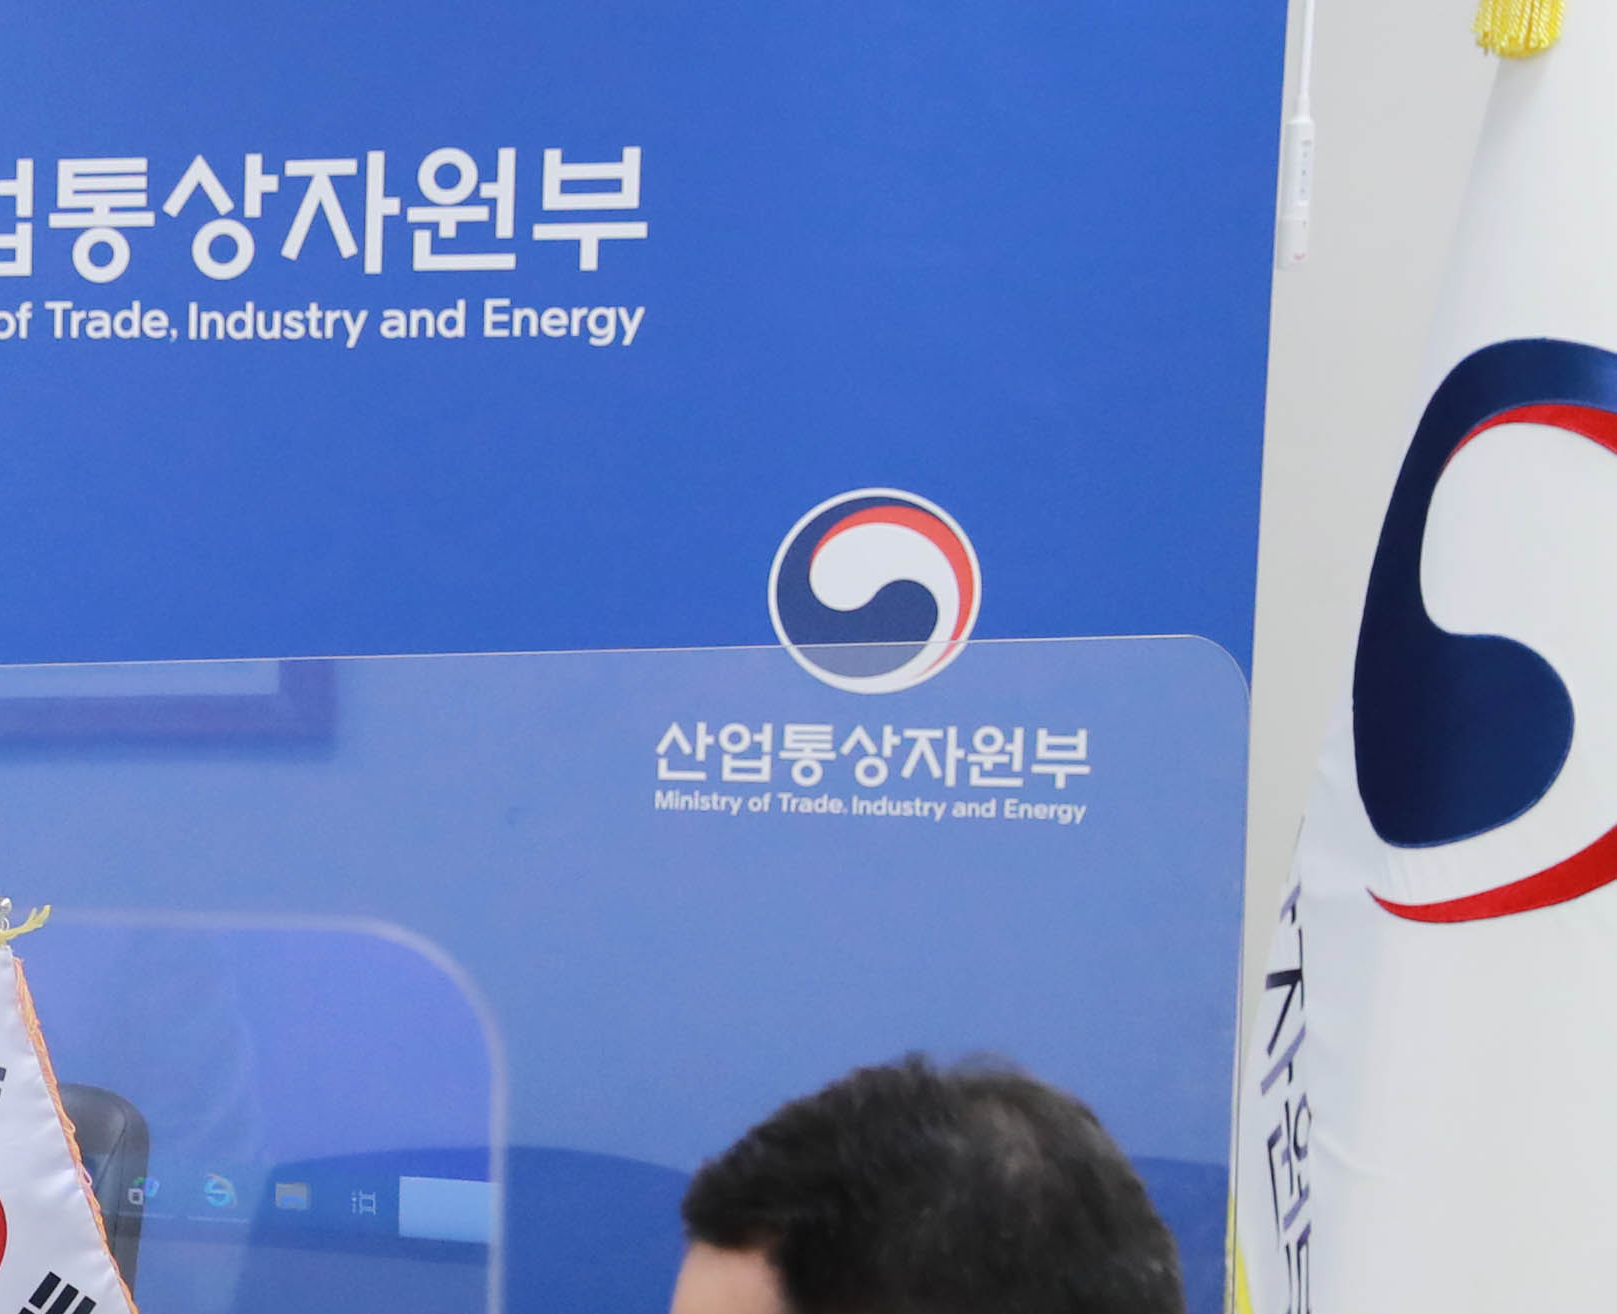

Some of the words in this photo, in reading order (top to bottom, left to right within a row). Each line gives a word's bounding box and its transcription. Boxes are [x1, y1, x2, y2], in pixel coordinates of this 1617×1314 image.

[45, 300, 178, 342] Trade,
[188, 301, 368, 348] Industry
[379, 299, 466, 338] and
[483, 298, 645, 346] Energy
[655, 721, 1091, 790] 산업통상자원부
[654, 789, 742, 816] Ministry
[748, 792, 771, 812] of
[852, 795, 946, 822] Industry
[952, 798, 996, 819] and
[1003, 798, 1086, 824] Energy
